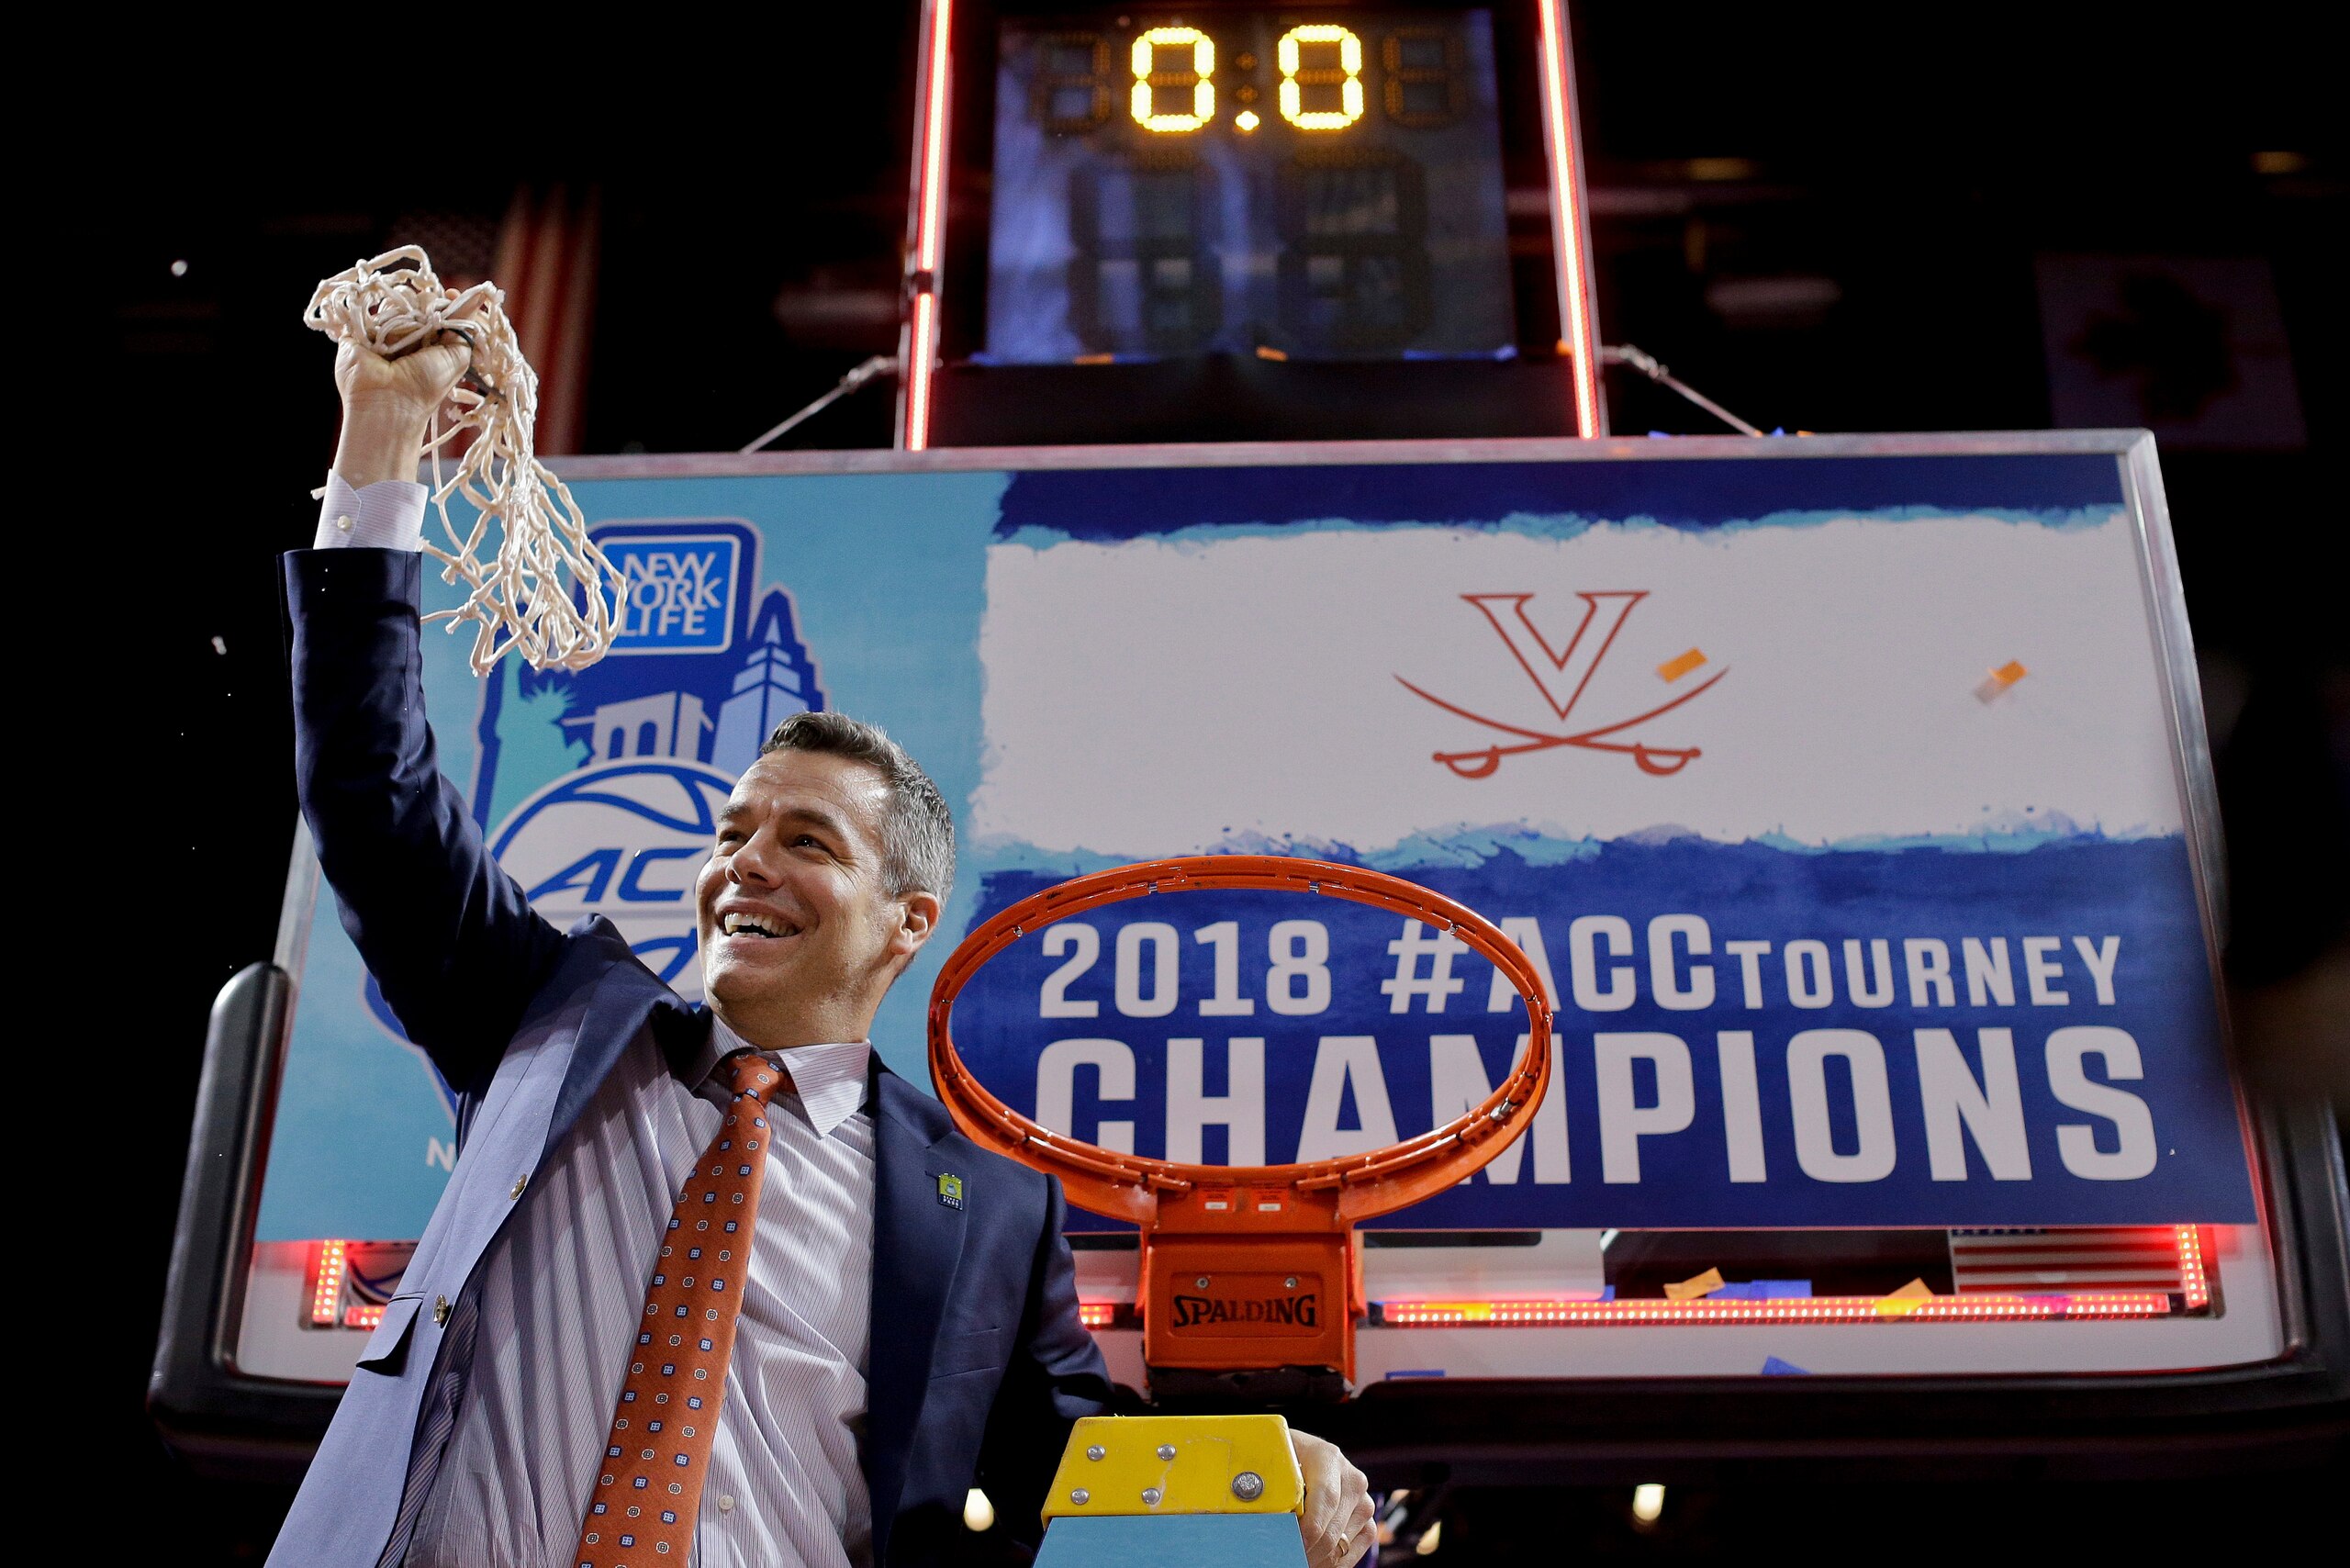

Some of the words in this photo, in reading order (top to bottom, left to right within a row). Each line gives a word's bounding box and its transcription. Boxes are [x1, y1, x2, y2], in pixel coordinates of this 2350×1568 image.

[1131, 23, 1365, 133] 0.0
[623, 552, 717, 583] NEW
[604, 577, 722, 612] YORK
[617, 605, 707, 637] LIFE
[526, 847, 707, 903] AC
[1039, 920, 1332, 1019] 2018
[1035, 1025, 2158, 1186] CHAMPIONS
[1173, 1294, 1316, 1328] SPALDING
